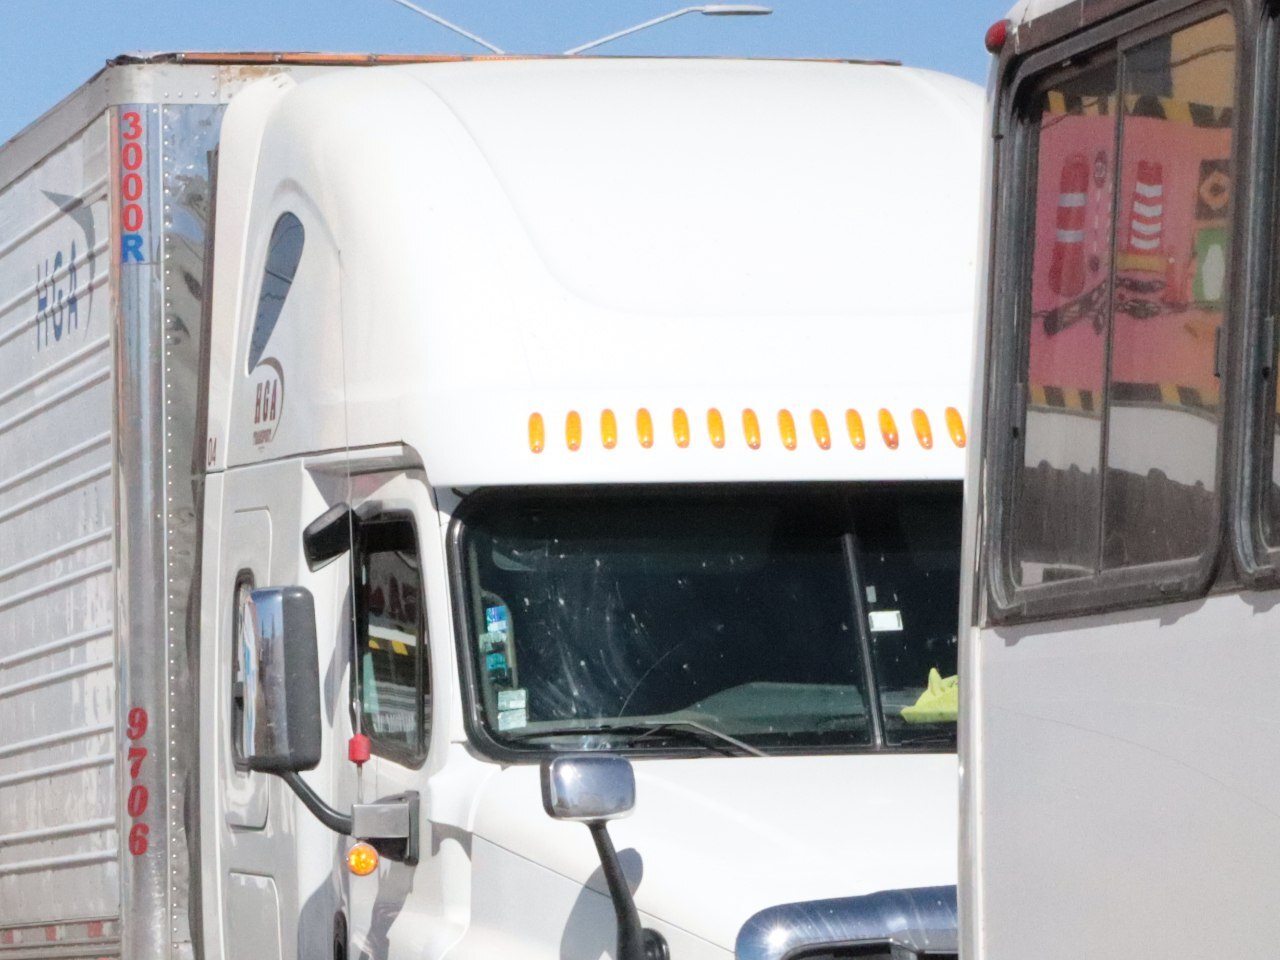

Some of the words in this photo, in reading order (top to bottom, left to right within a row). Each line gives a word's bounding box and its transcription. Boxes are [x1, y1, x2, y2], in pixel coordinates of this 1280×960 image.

[121, 111, 146, 264] 3000R
[254, 378, 278, 425] HGA
[125, 706, 150, 856] 9706
